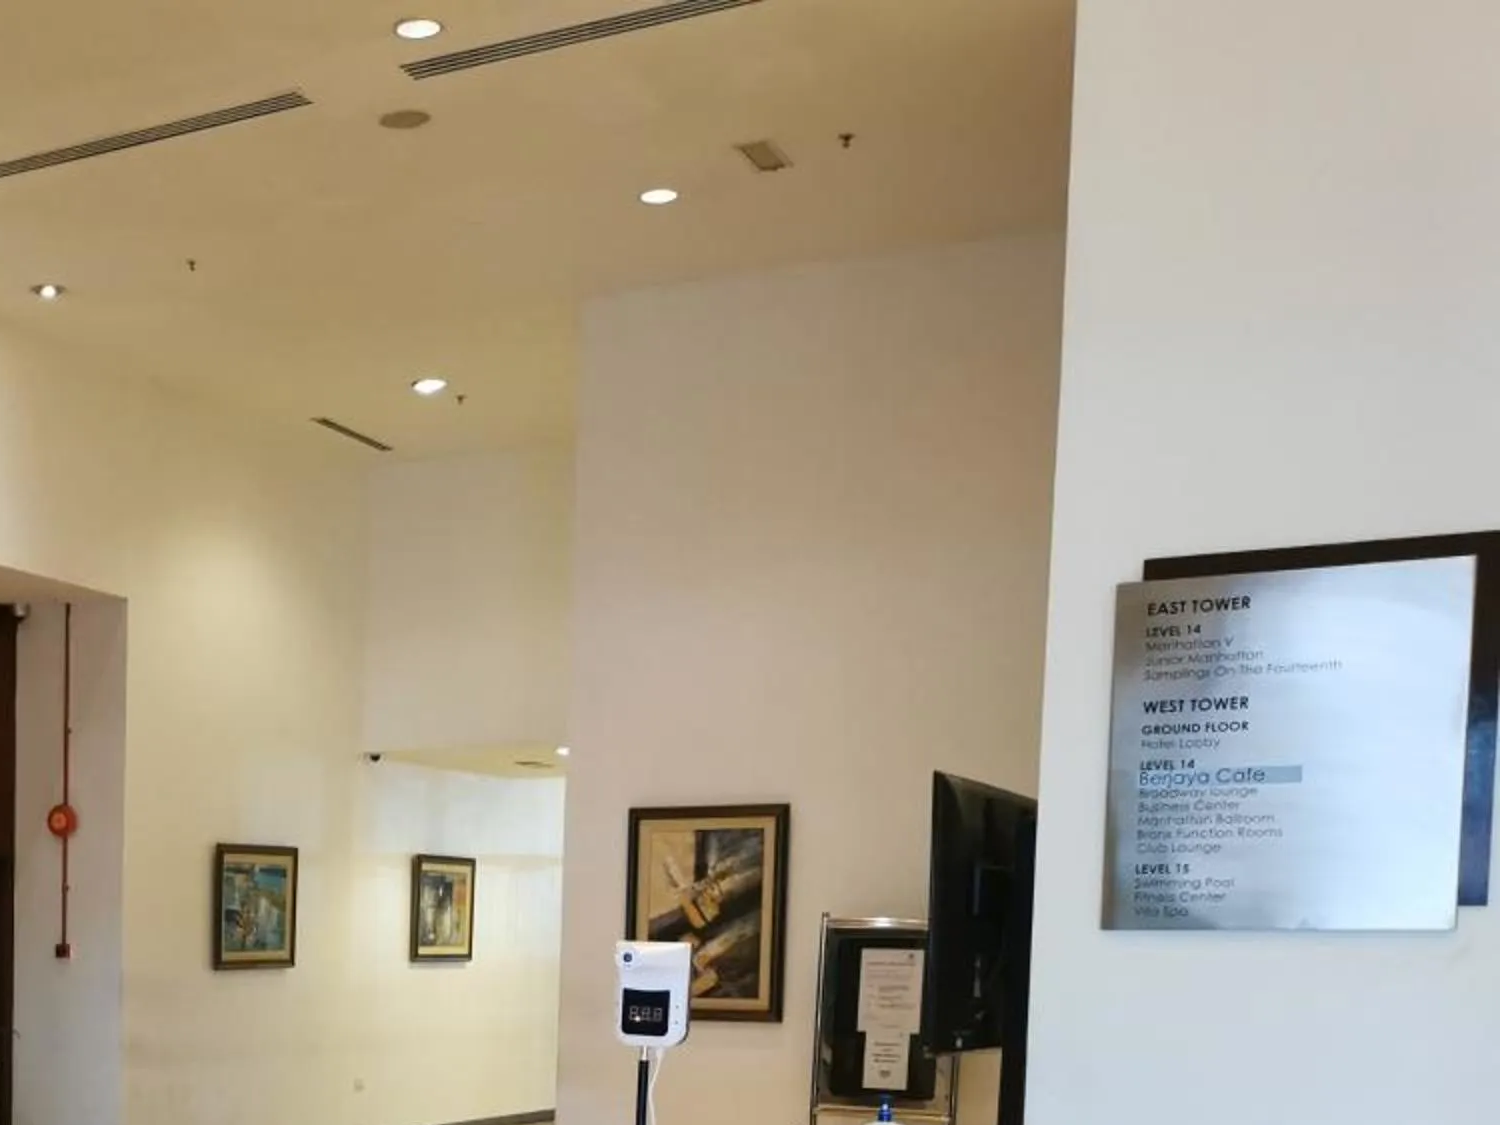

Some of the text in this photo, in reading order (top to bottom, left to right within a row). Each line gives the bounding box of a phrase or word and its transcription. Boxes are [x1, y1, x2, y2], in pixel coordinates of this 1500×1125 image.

[1147, 595, 1251, 617] EAST TOWER
[1146, 624, 1202, 637] LEVEL 14
[1143, 696, 1249, 714] WEST TOWER
[1141, 721, 1249, 735] GROUND FLOOR
[1139, 759, 1195, 771] LEVEL 14
[1139, 771, 1210, 788] Berjaya
[1134, 863, 1190, 875] LEVEL 15
